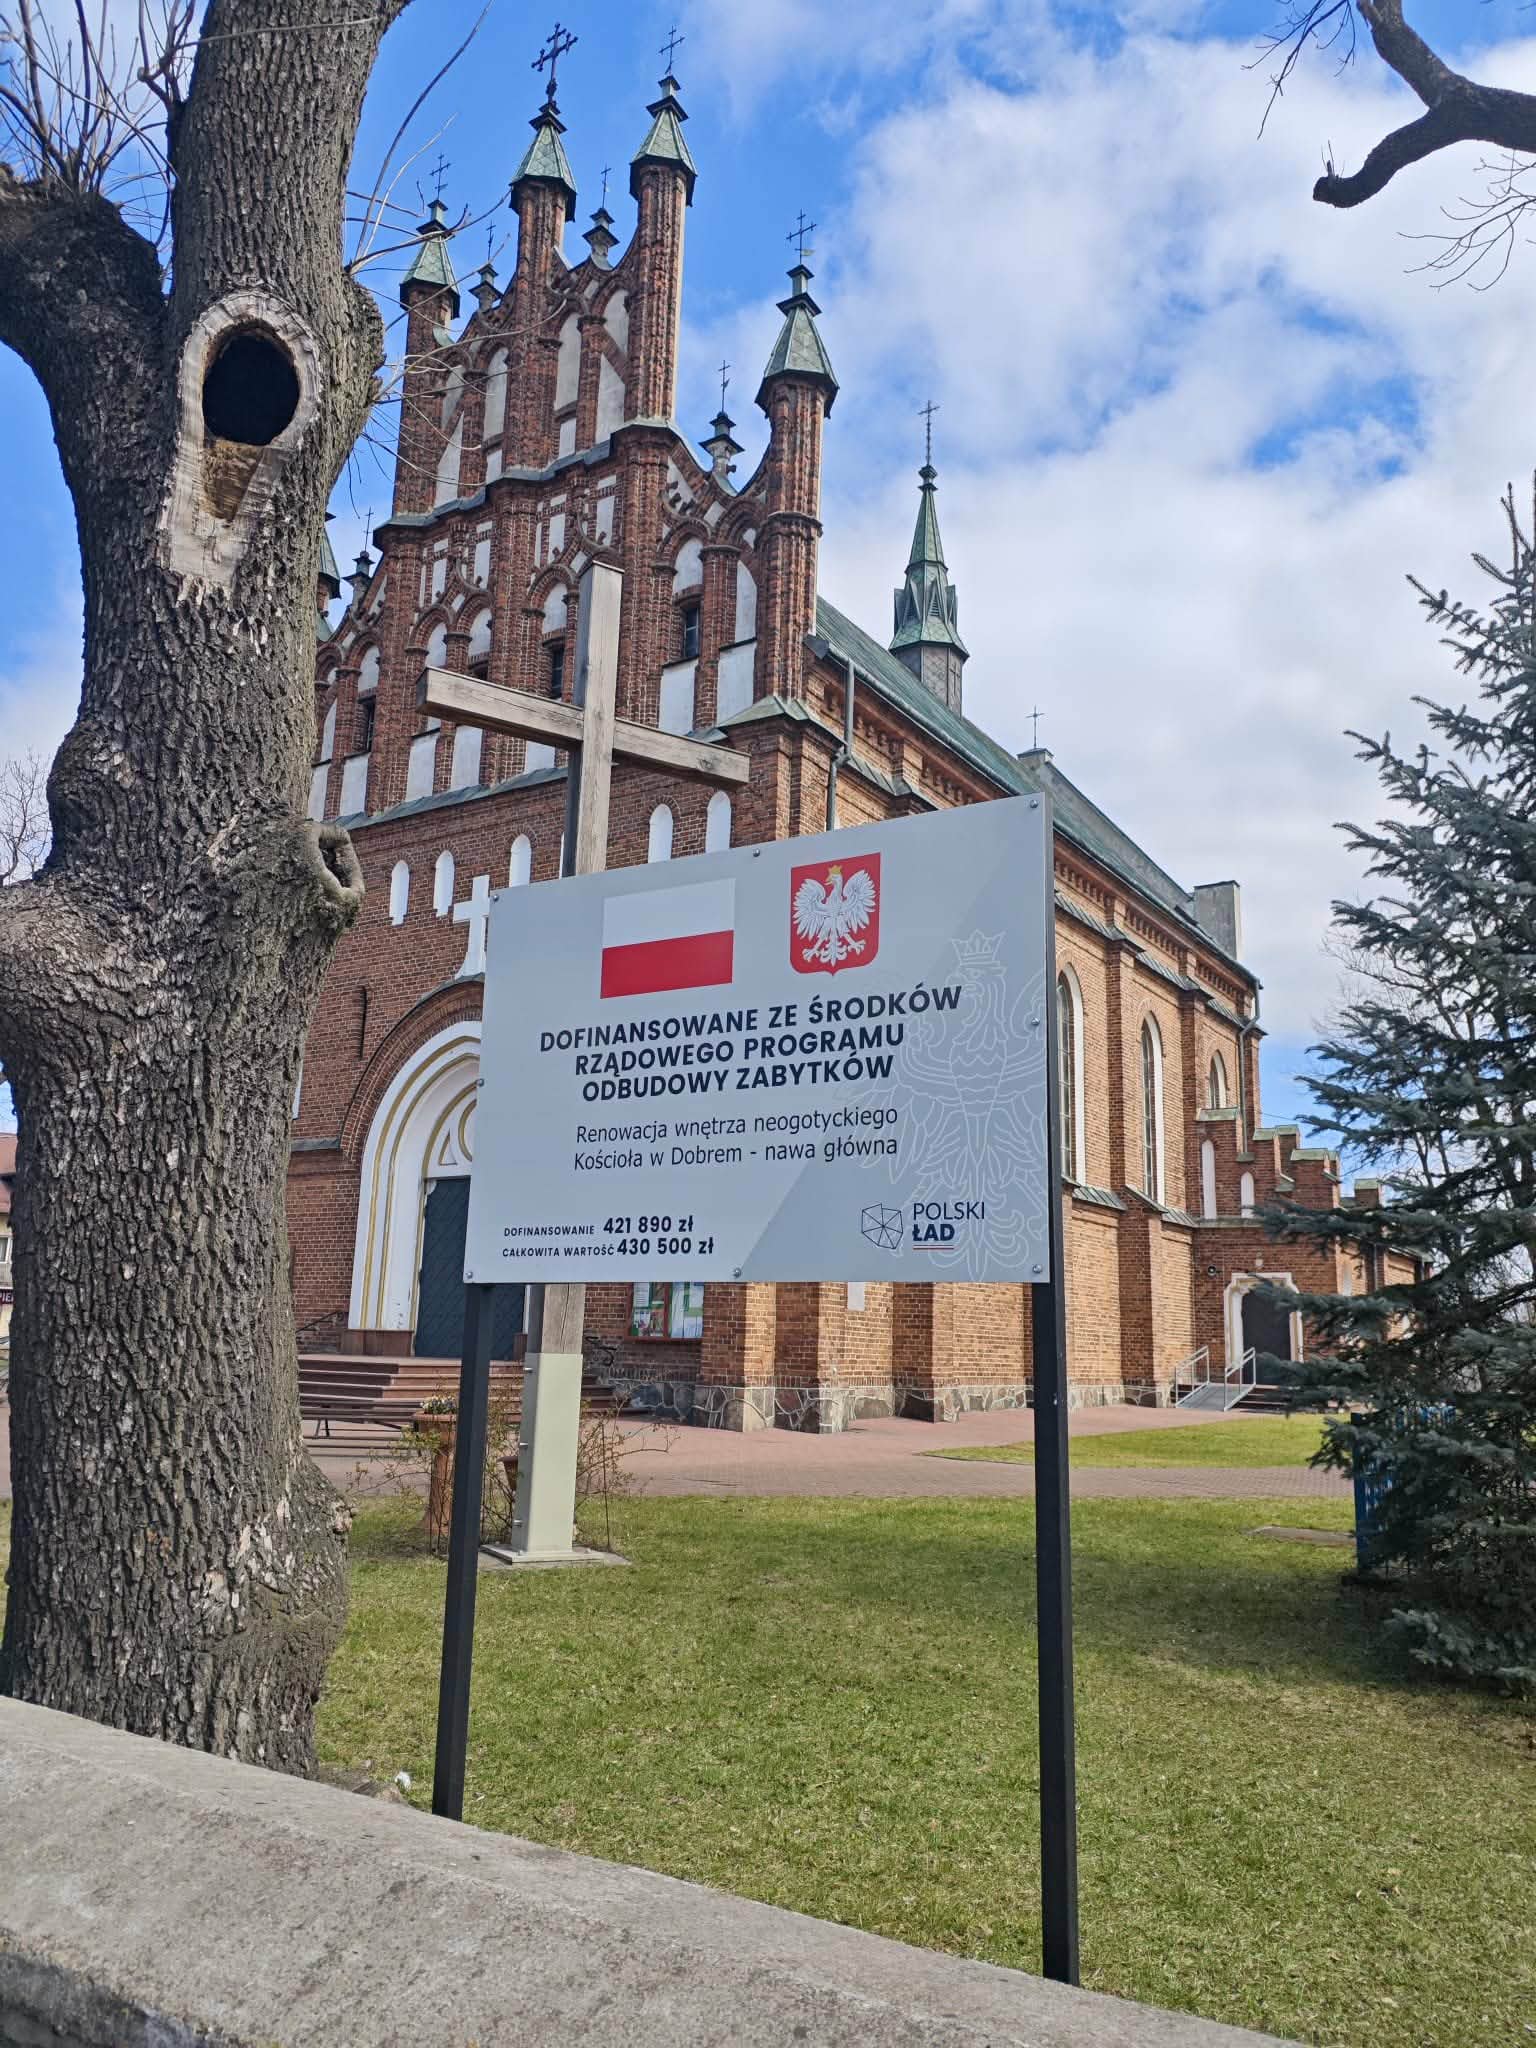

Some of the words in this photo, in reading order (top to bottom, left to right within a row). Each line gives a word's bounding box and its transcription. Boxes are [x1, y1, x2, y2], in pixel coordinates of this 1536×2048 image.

[540, 1009, 759, 1053] DOFINANSOWANE
[768, 1004, 798, 1030] ZE
[808, 982, 963, 1025] ŚRODKÓW
[575, 1040, 735, 1078] RZĄDOWEGO
[743, 1023, 905, 1060] PROGRAMU
[582, 1069, 731, 1102] ODBUDOWY
[736, 1052, 894, 1090] ZABYTKÓW
[576, 1120, 668, 1144] Renowacja
[674, 1117, 747, 1140] wnętrza
[754, 1106, 899, 1135] neogotyckiego
[574, 1148, 643, 1171] Kościoła
[650, 1151, 665, 1168] w
[671, 1145, 743, 1166] Dobrem
[765, 1141, 816, 1161] nawa
[823, 1135, 898, 1162] główna
[503, 1225, 595, 1237] DOFINANSOWANIE
[602, 1216, 632, 1235] 421
[637, 1215, 673, 1234] 890
[677, 1214, 694, 1233] zł
[913, 1201, 985, 1220] POLSKI
[502, 1246, 561, 1257] CAŁKOWITA
[563, 1243, 615, 1257] WARTOŚĆ
[616, 1238, 651, 1256] 430
[657, 1237, 692, 1255] 500
[698, 1236, 715, 1255] zł
[912, 1223, 956, 1242] ŁAD
